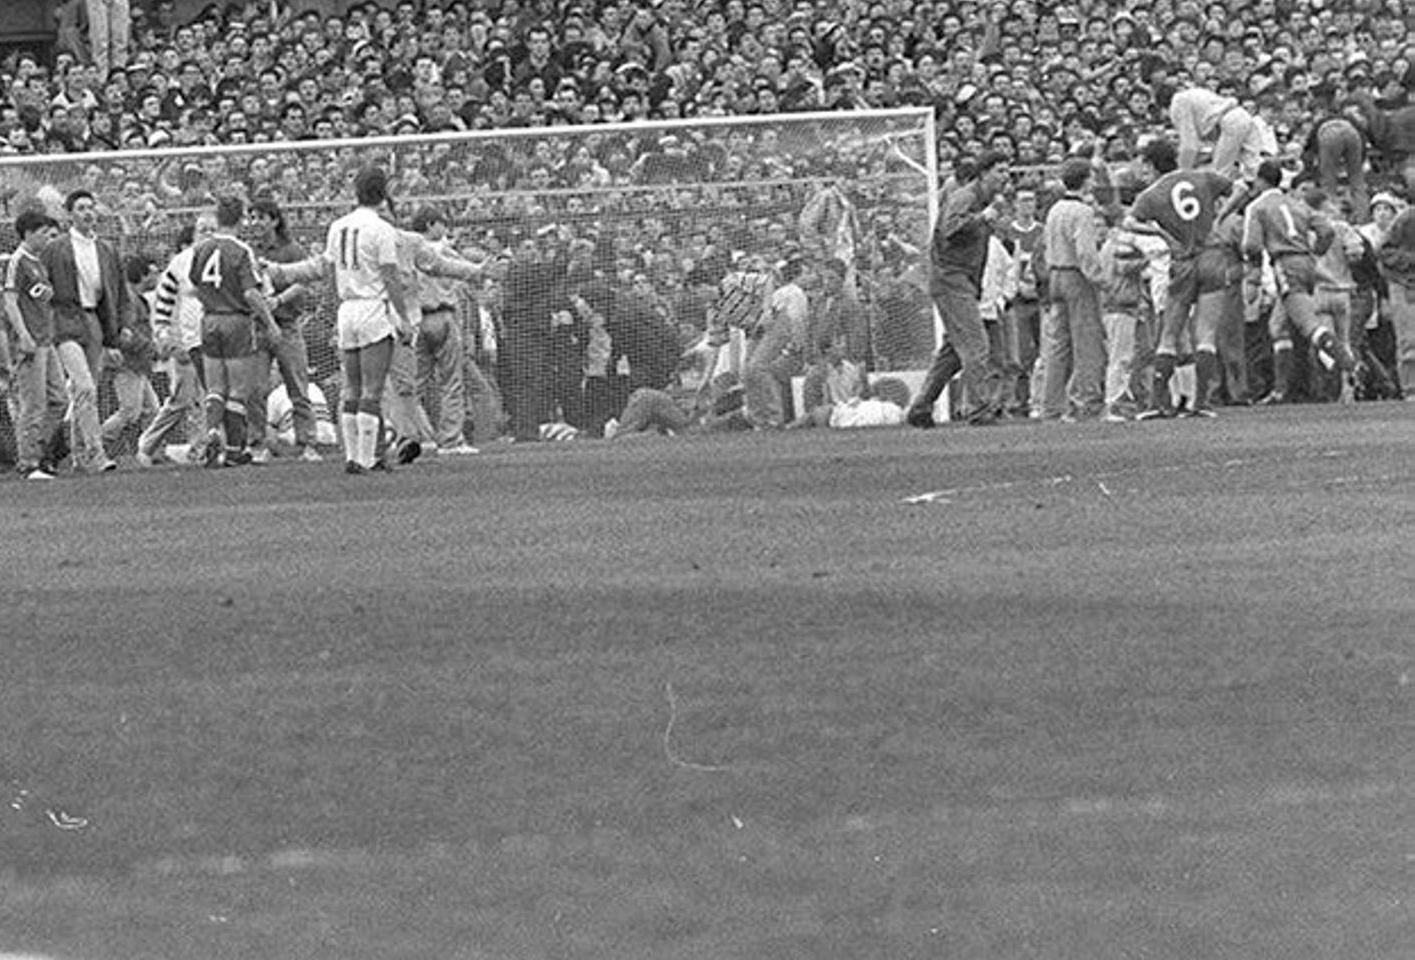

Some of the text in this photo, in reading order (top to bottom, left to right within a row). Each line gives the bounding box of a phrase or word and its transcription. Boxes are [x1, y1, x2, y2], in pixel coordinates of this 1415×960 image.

[1171, 181, 1201, 221] 6
[201, 248, 222, 289] 4
[339, 226, 361, 270] 11
